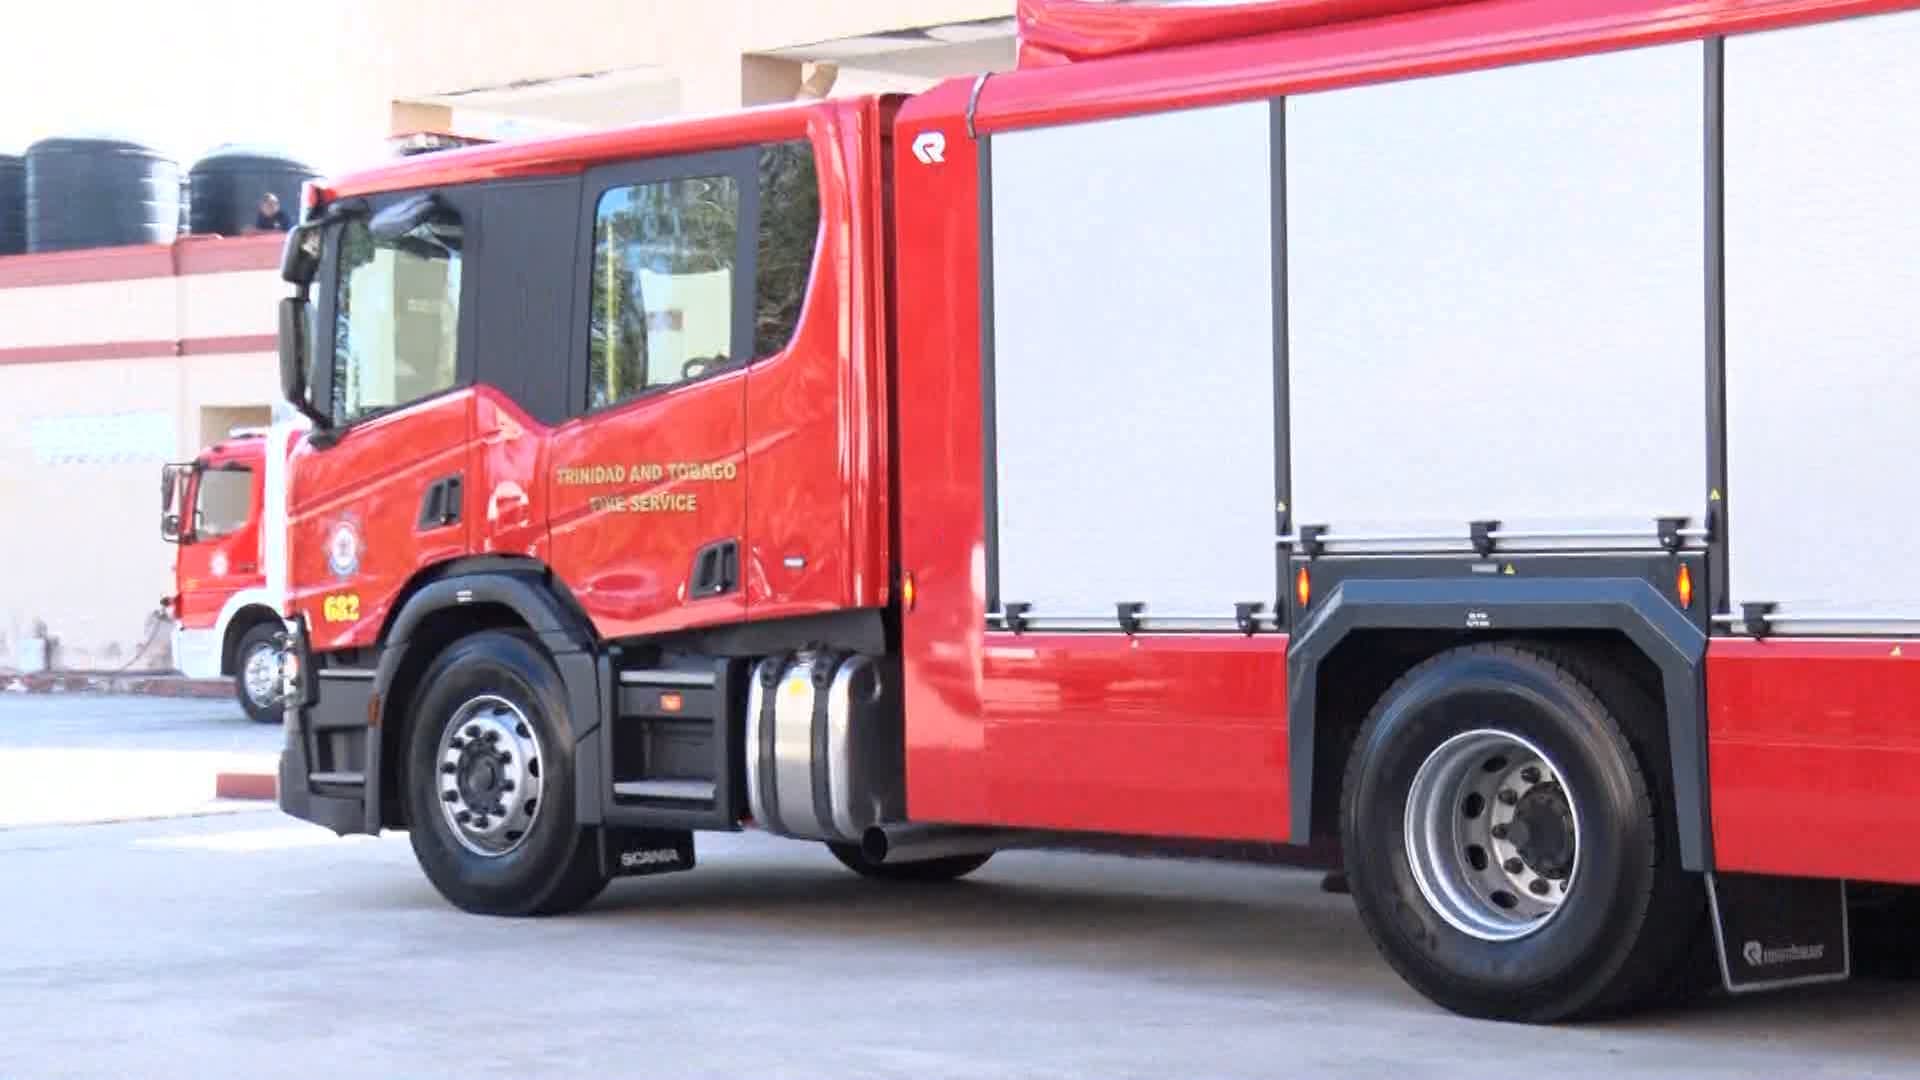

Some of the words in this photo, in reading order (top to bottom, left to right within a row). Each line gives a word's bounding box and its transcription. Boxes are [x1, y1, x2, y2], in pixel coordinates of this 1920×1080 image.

[558, 465, 625, 485] TRINIDAD
[629, 463, 662, 482] AND
[667, 462, 737, 481] TOBAGO
[629, 493, 697, 512] SERVICE
[323, 594, 360, 622] 682
